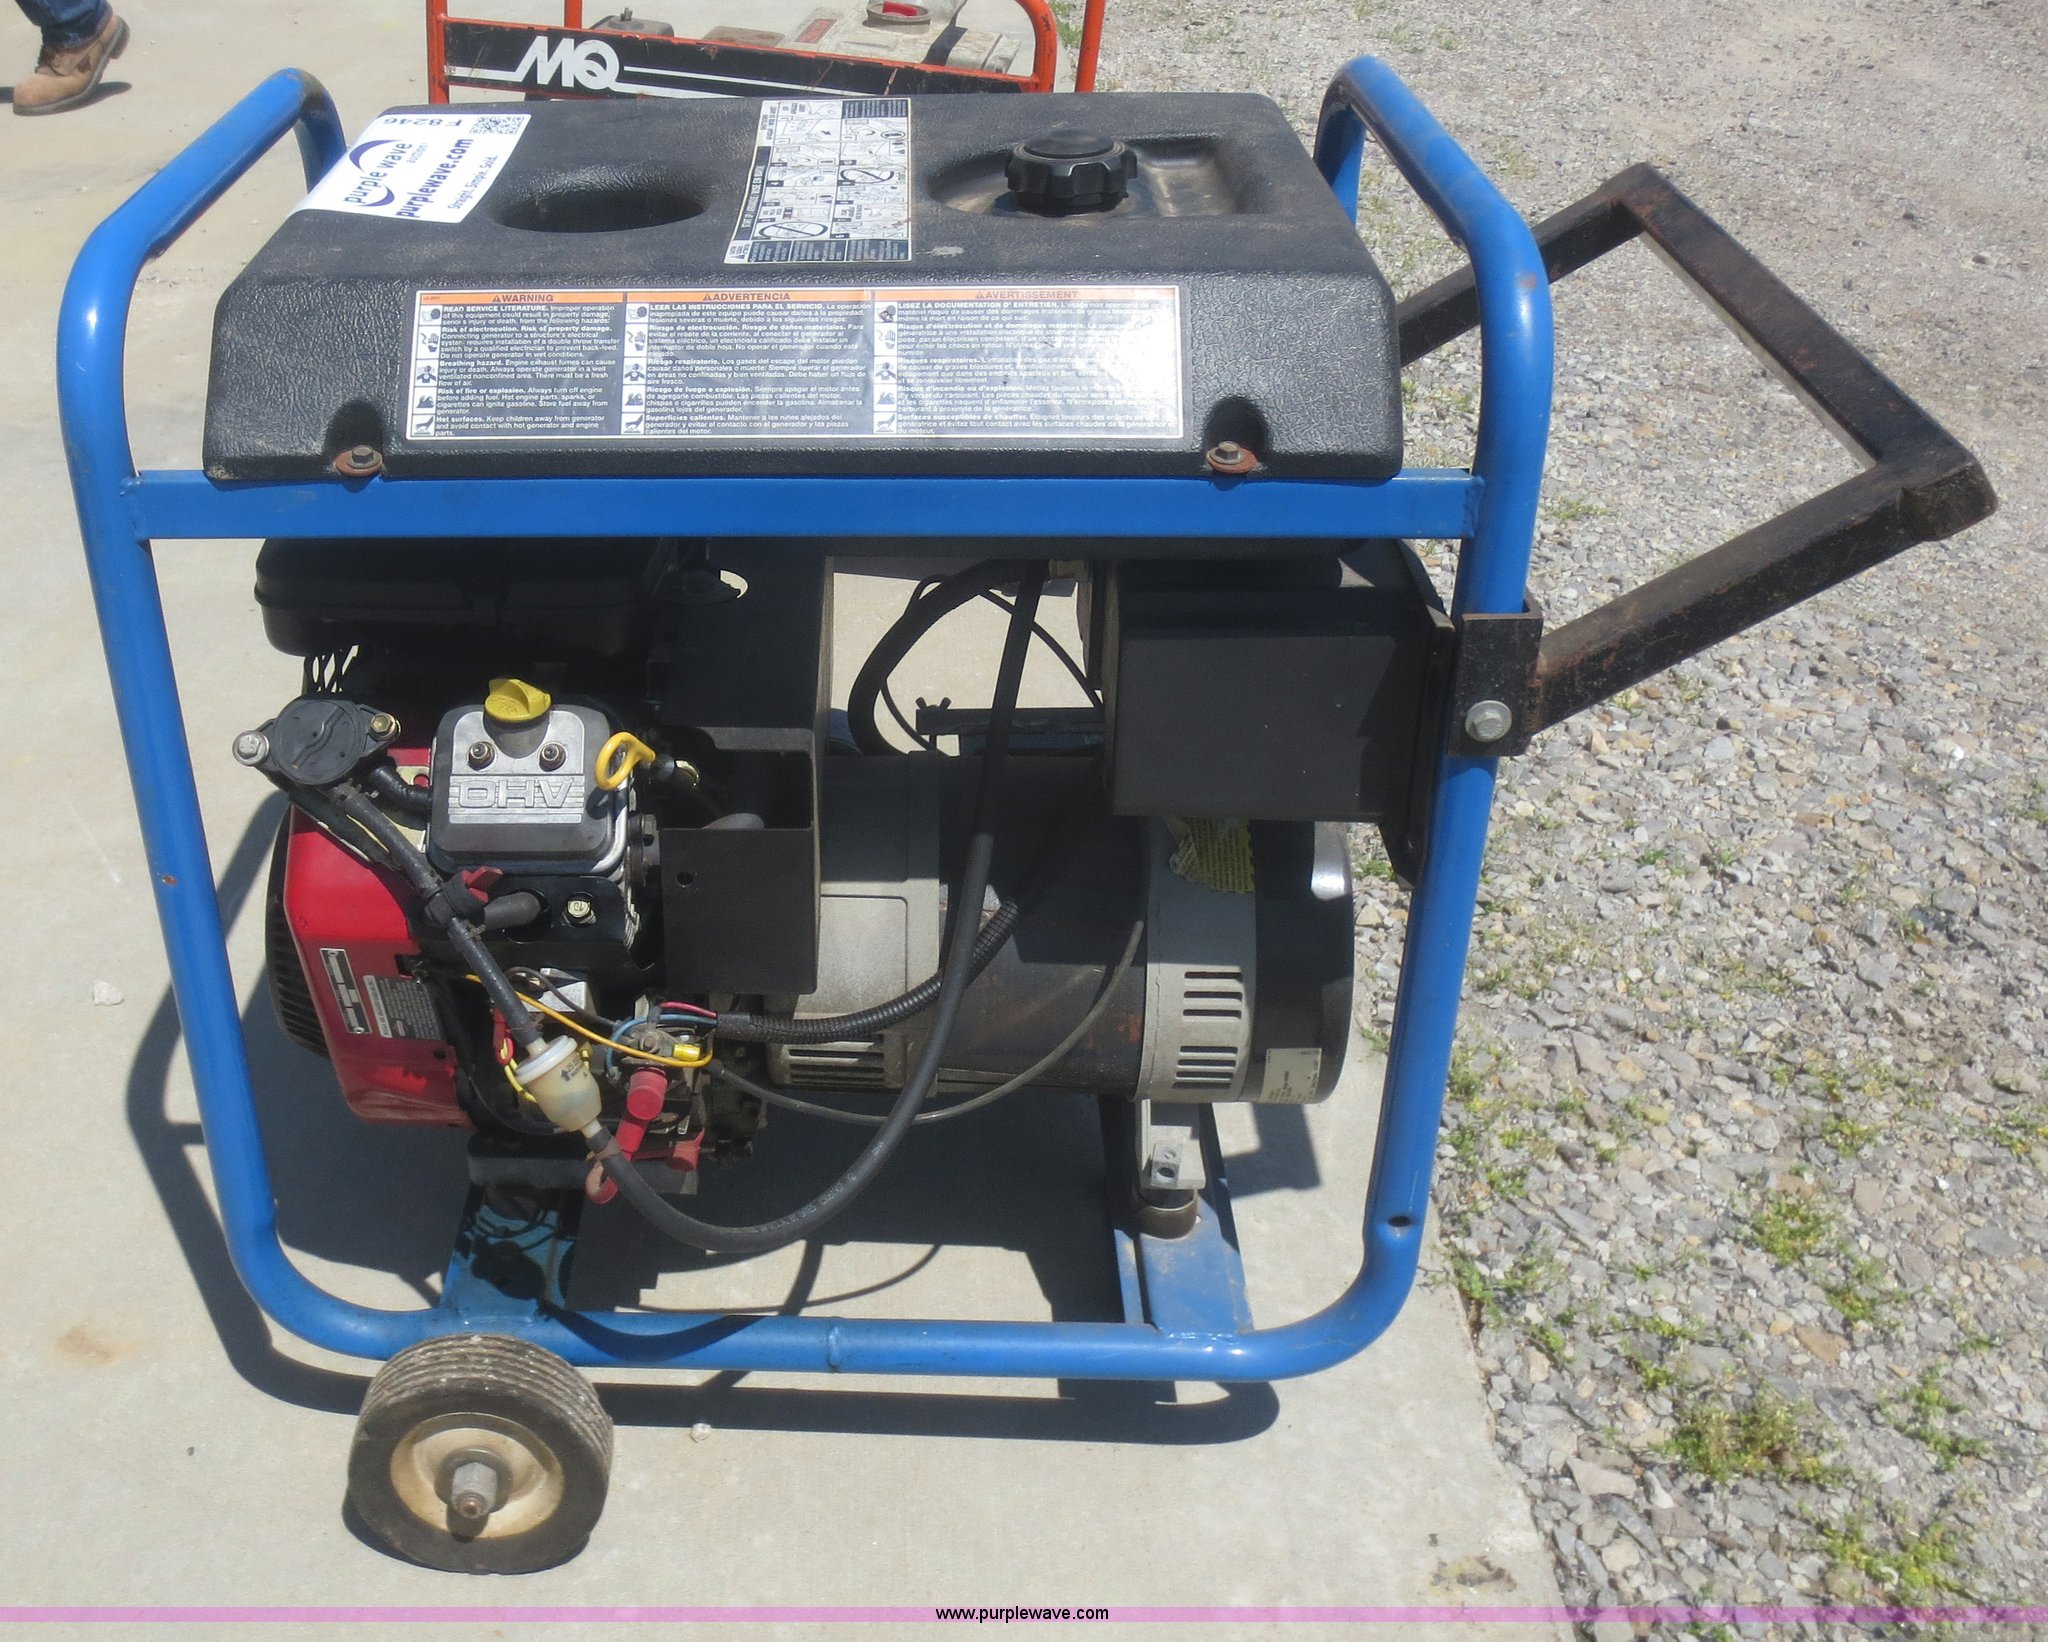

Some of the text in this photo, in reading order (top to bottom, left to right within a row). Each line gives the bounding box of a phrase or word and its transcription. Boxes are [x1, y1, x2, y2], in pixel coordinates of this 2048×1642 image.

[516, 36, 619, 90] MQ
[343, 142, 413, 204] purple wave
[396, 138, 474, 218] purplewave.com
[502, 294, 554, 302] WARNING
[984, 290, 1078, 299] AVERTISSEMENT
[458, 780, 574, 808] OHV
